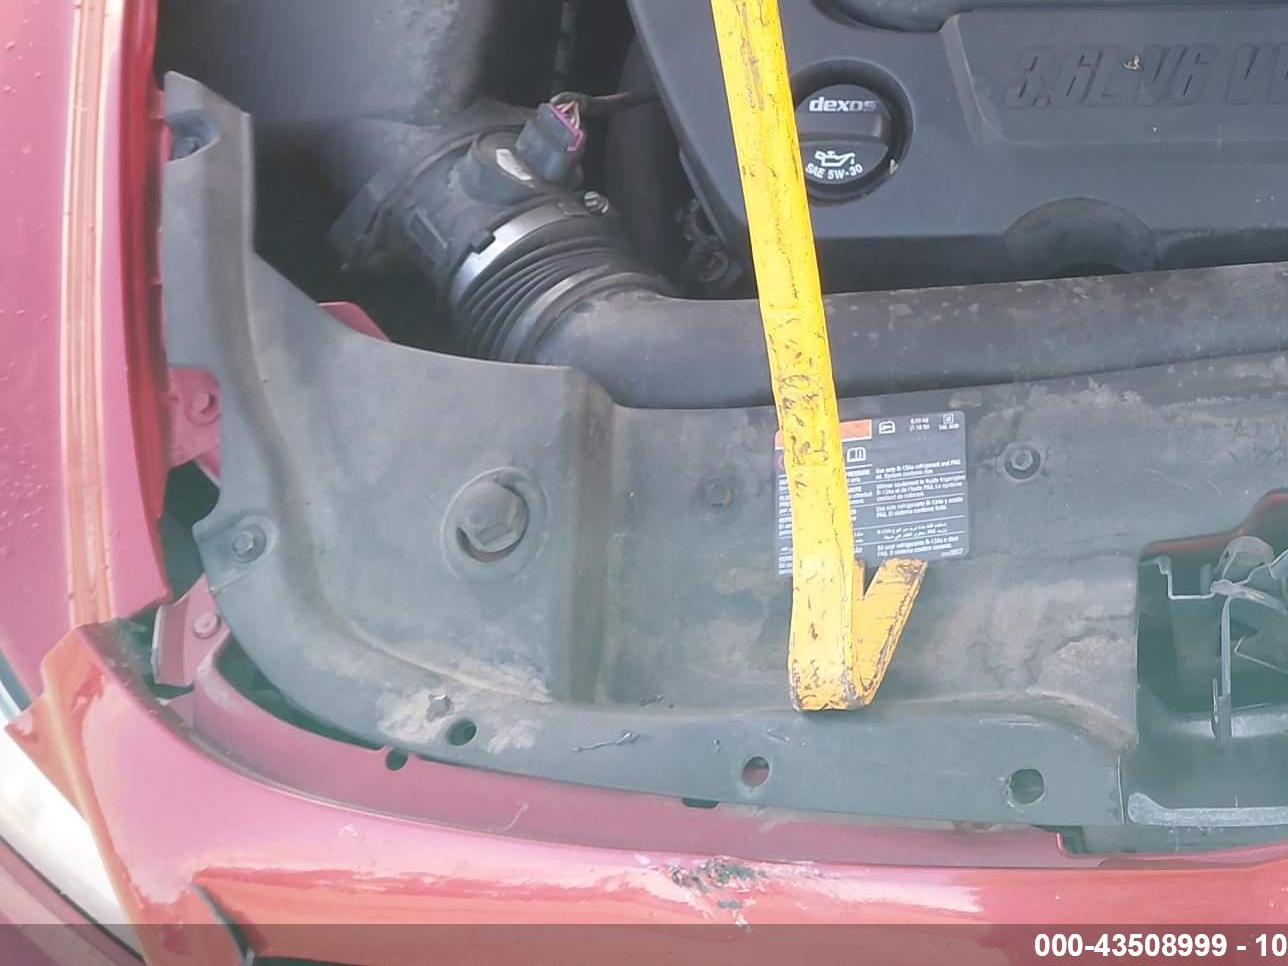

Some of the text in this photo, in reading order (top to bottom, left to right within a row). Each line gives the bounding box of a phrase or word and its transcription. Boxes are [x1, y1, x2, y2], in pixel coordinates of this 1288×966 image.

[1003, 44, 1121, 109] 3.6L
[1136, 43, 1219, 108] V6
[809, 96, 877, 112] dexos
[805, 163, 863, 180] SAE 5W-30
